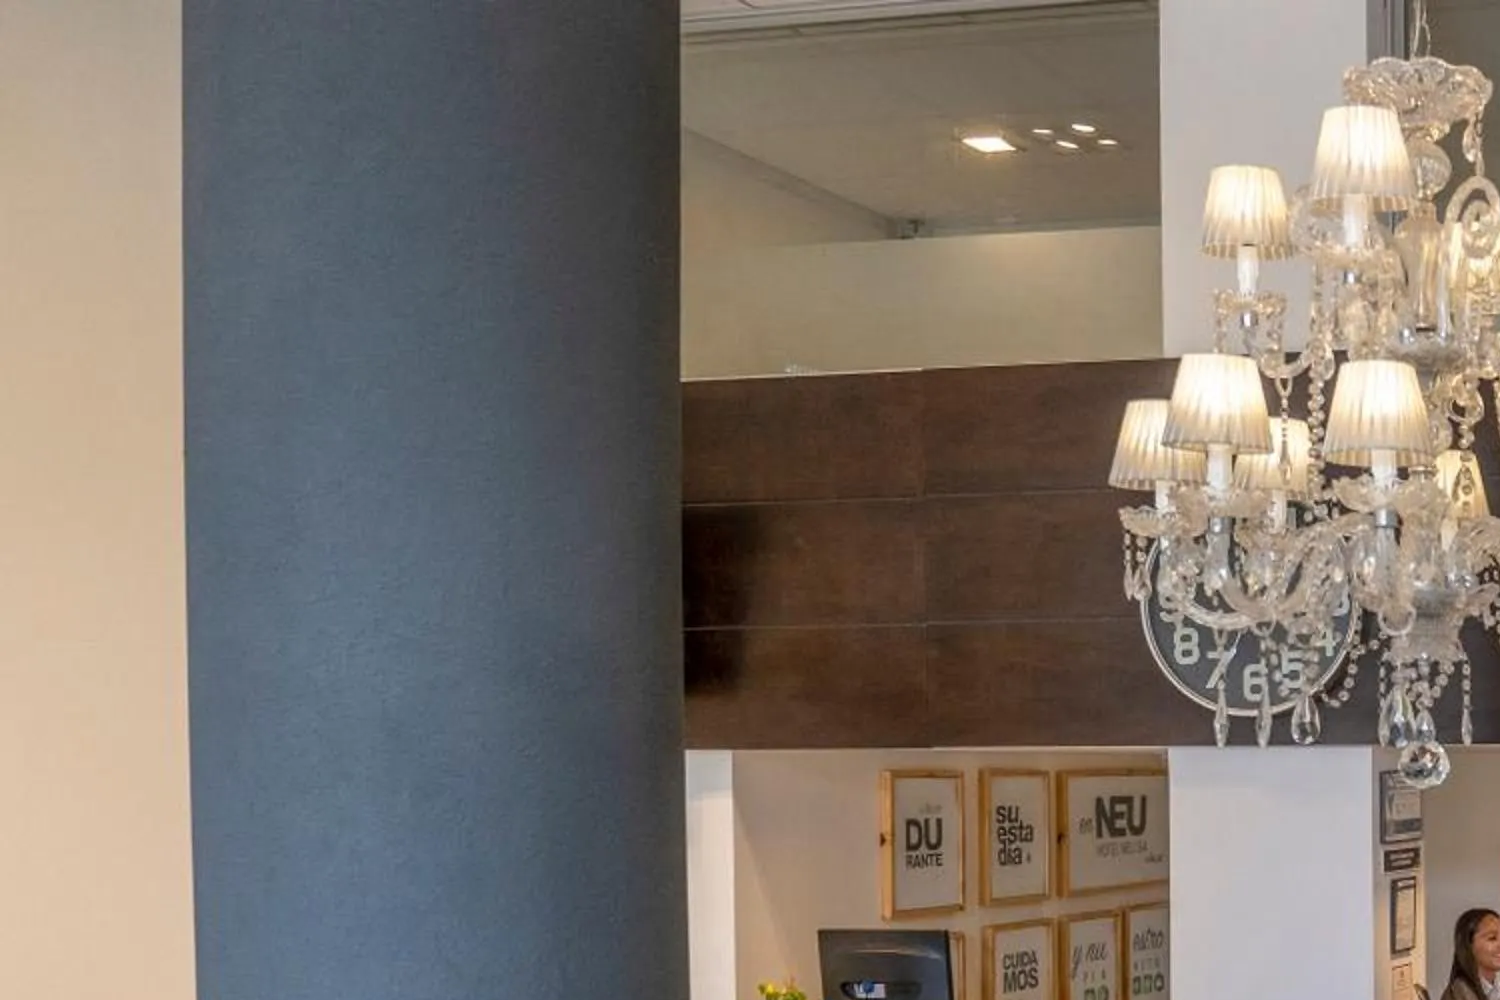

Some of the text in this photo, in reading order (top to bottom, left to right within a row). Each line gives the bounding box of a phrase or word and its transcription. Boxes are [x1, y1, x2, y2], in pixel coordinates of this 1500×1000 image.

[1173, 627, 1200, 665] 8
[1206, 651, 1235, 688] 7
[1243, 664, 1268, 702] 6
[997, 820, 1034, 844] esta
[1095, 795, 1146, 838] NEU
[905, 818, 942, 851] DU
[906, 853, 943, 869] RANTE
[1003, 951, 1038, 970] CUIDA
[1003, 968, 1038, 993] MOS
